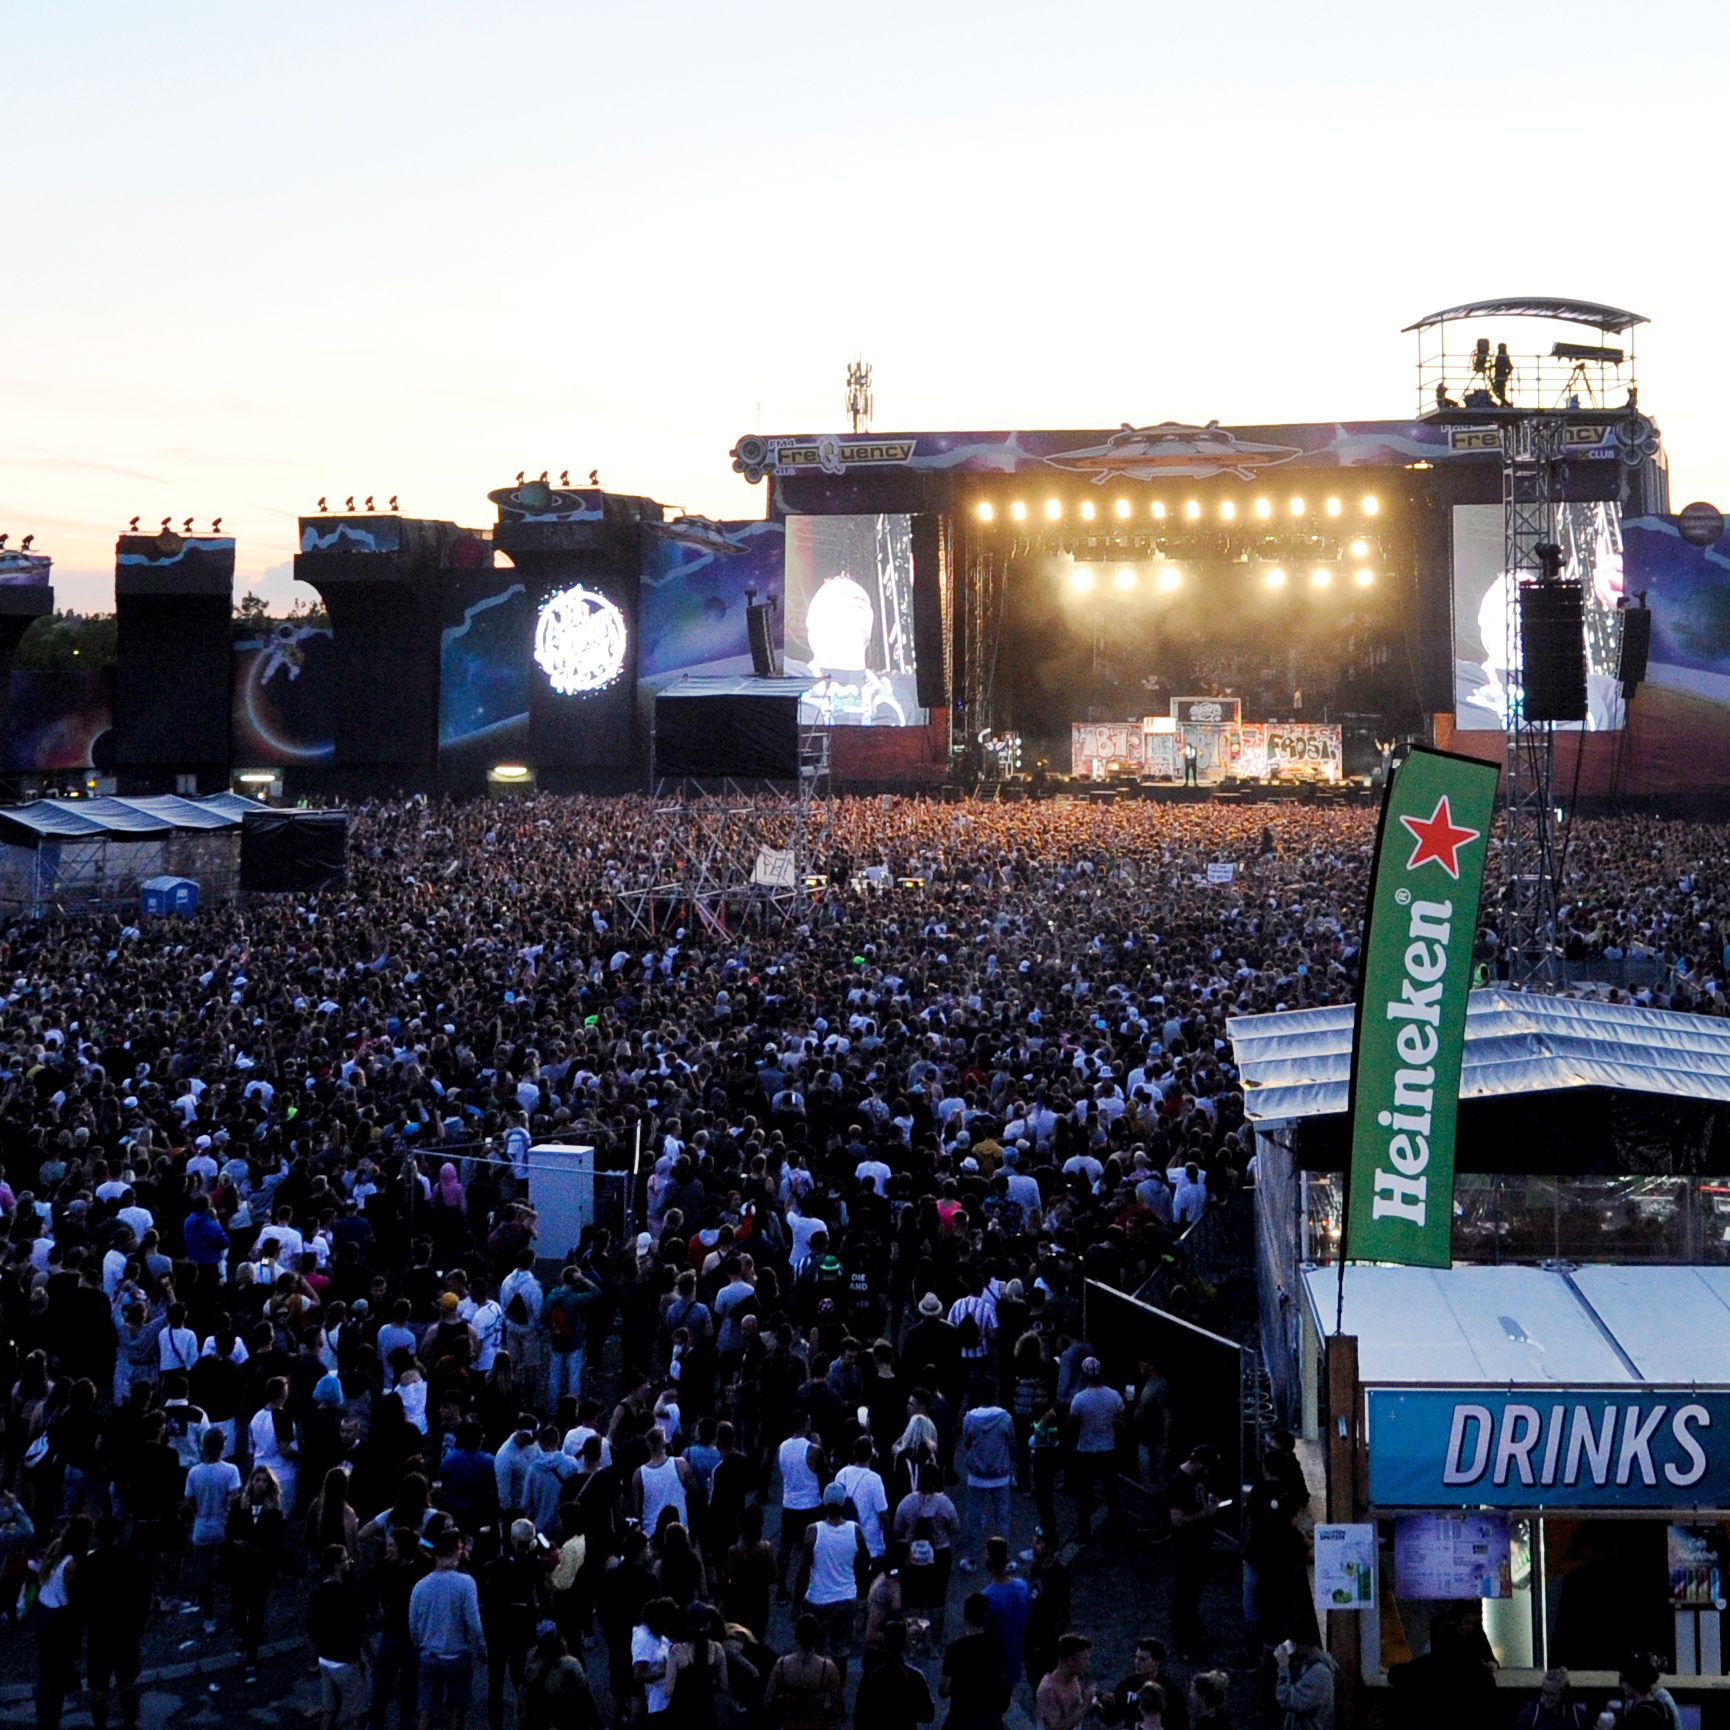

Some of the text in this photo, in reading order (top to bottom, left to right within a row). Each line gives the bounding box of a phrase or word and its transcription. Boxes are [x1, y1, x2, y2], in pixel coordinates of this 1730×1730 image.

[1588, 450, 1616, 459] CLUB
[1372, 900, 1453, 1225] Heineken
[1443, 1404, 1711, 1486] DRINKS
